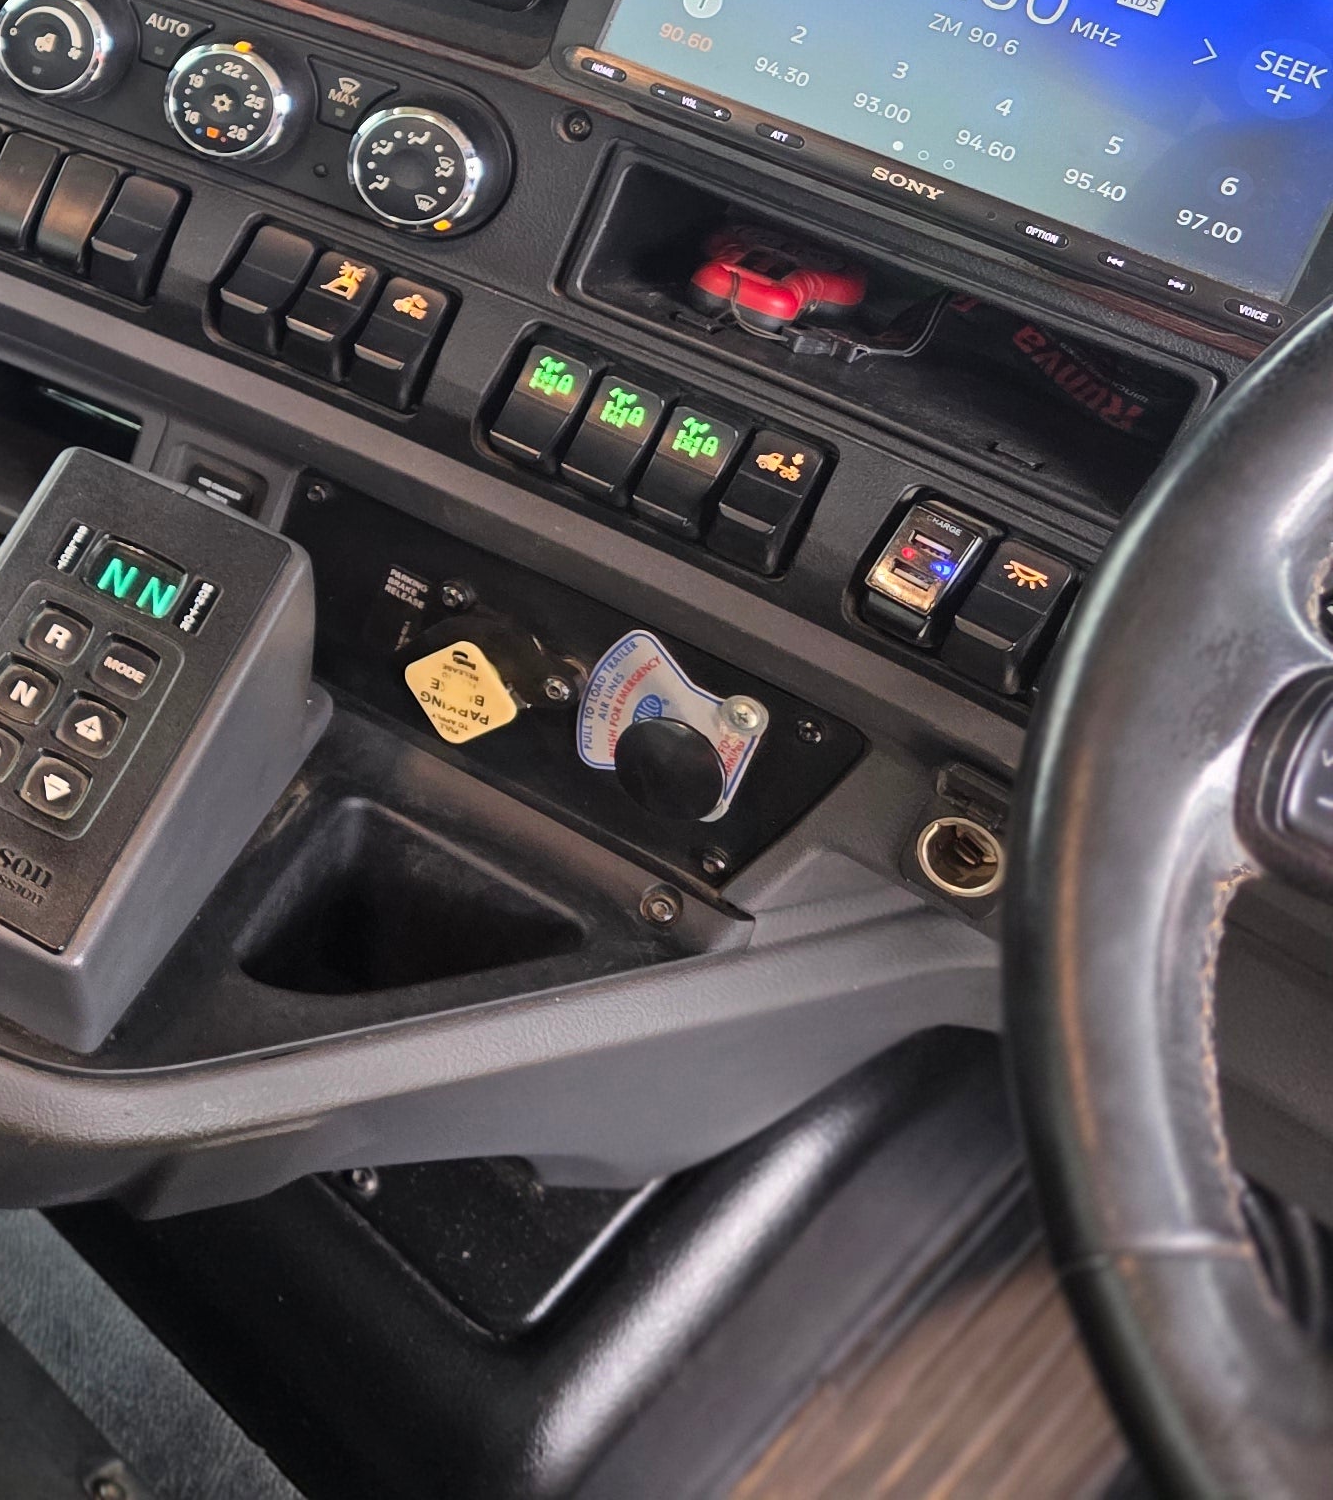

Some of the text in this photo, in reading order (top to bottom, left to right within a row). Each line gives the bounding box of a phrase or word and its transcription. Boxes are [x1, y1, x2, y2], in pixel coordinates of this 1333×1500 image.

[145, 11, 191, 39] AUTO
[790, 25, 808, 45] 2
[929, 13, 1020, 57] ZM 90.6
[1069, 18, 1122, 48] MHz
[659, 21, 713, 53] 90.60
[188, 73, 204, 88] 19
[221, 61, 244, 78] 22
[591, 62, 615, 78] HOME
[754, 56, 810, 88] 94.30
[892, 61, 909, 80] 3
[1255, 50, 1329, 91] SEEK
[244, 93, 266, 110] 25
[328, 87, 361, 110] MAX
[682, 96, 697, 109] VOL
[853, 92, 912, 125] 93.00
[994, 97, 1014, 118] 4
[184, 109, 201, 125] 16
[226, 124, 248, 141] 28
[769, 130, 790, 143] ATT
[955, 128, 1017, 163] 94.60
[1104, 135, 1123, 156] 5
[871, 166, 944, 200] SONY
[1063, 167, 1127, 204] 95.40
[1220, 175, 1239, 197] 6
[1025, 225, 1059, 244] OPTION
[1176, 209, 1242, 244] 97.00
[1238, 304, 1269, 323] VOICE
[927, 515, 963, 537] CHARGE
[387, 576, 418, 597] BRAKE
[390, 568, 429, 593] PARKING
[384, 583, 426, 610] RELEASE
[44, 623, 72, 650] R
[103, 655, 147, 685] MODE
[442, 664, 479, 682] RELEASE
[10, 681, 38, 709] N
[584, 641, 639, 750] PULL TO LOAD TRAILER
[598, 672, 625, 721] AIR LINES
[610, 706, 622, 727] FOR
[617, 655, 662, 706] EMERGENCY
[440, 721, 460, 736] PULL
